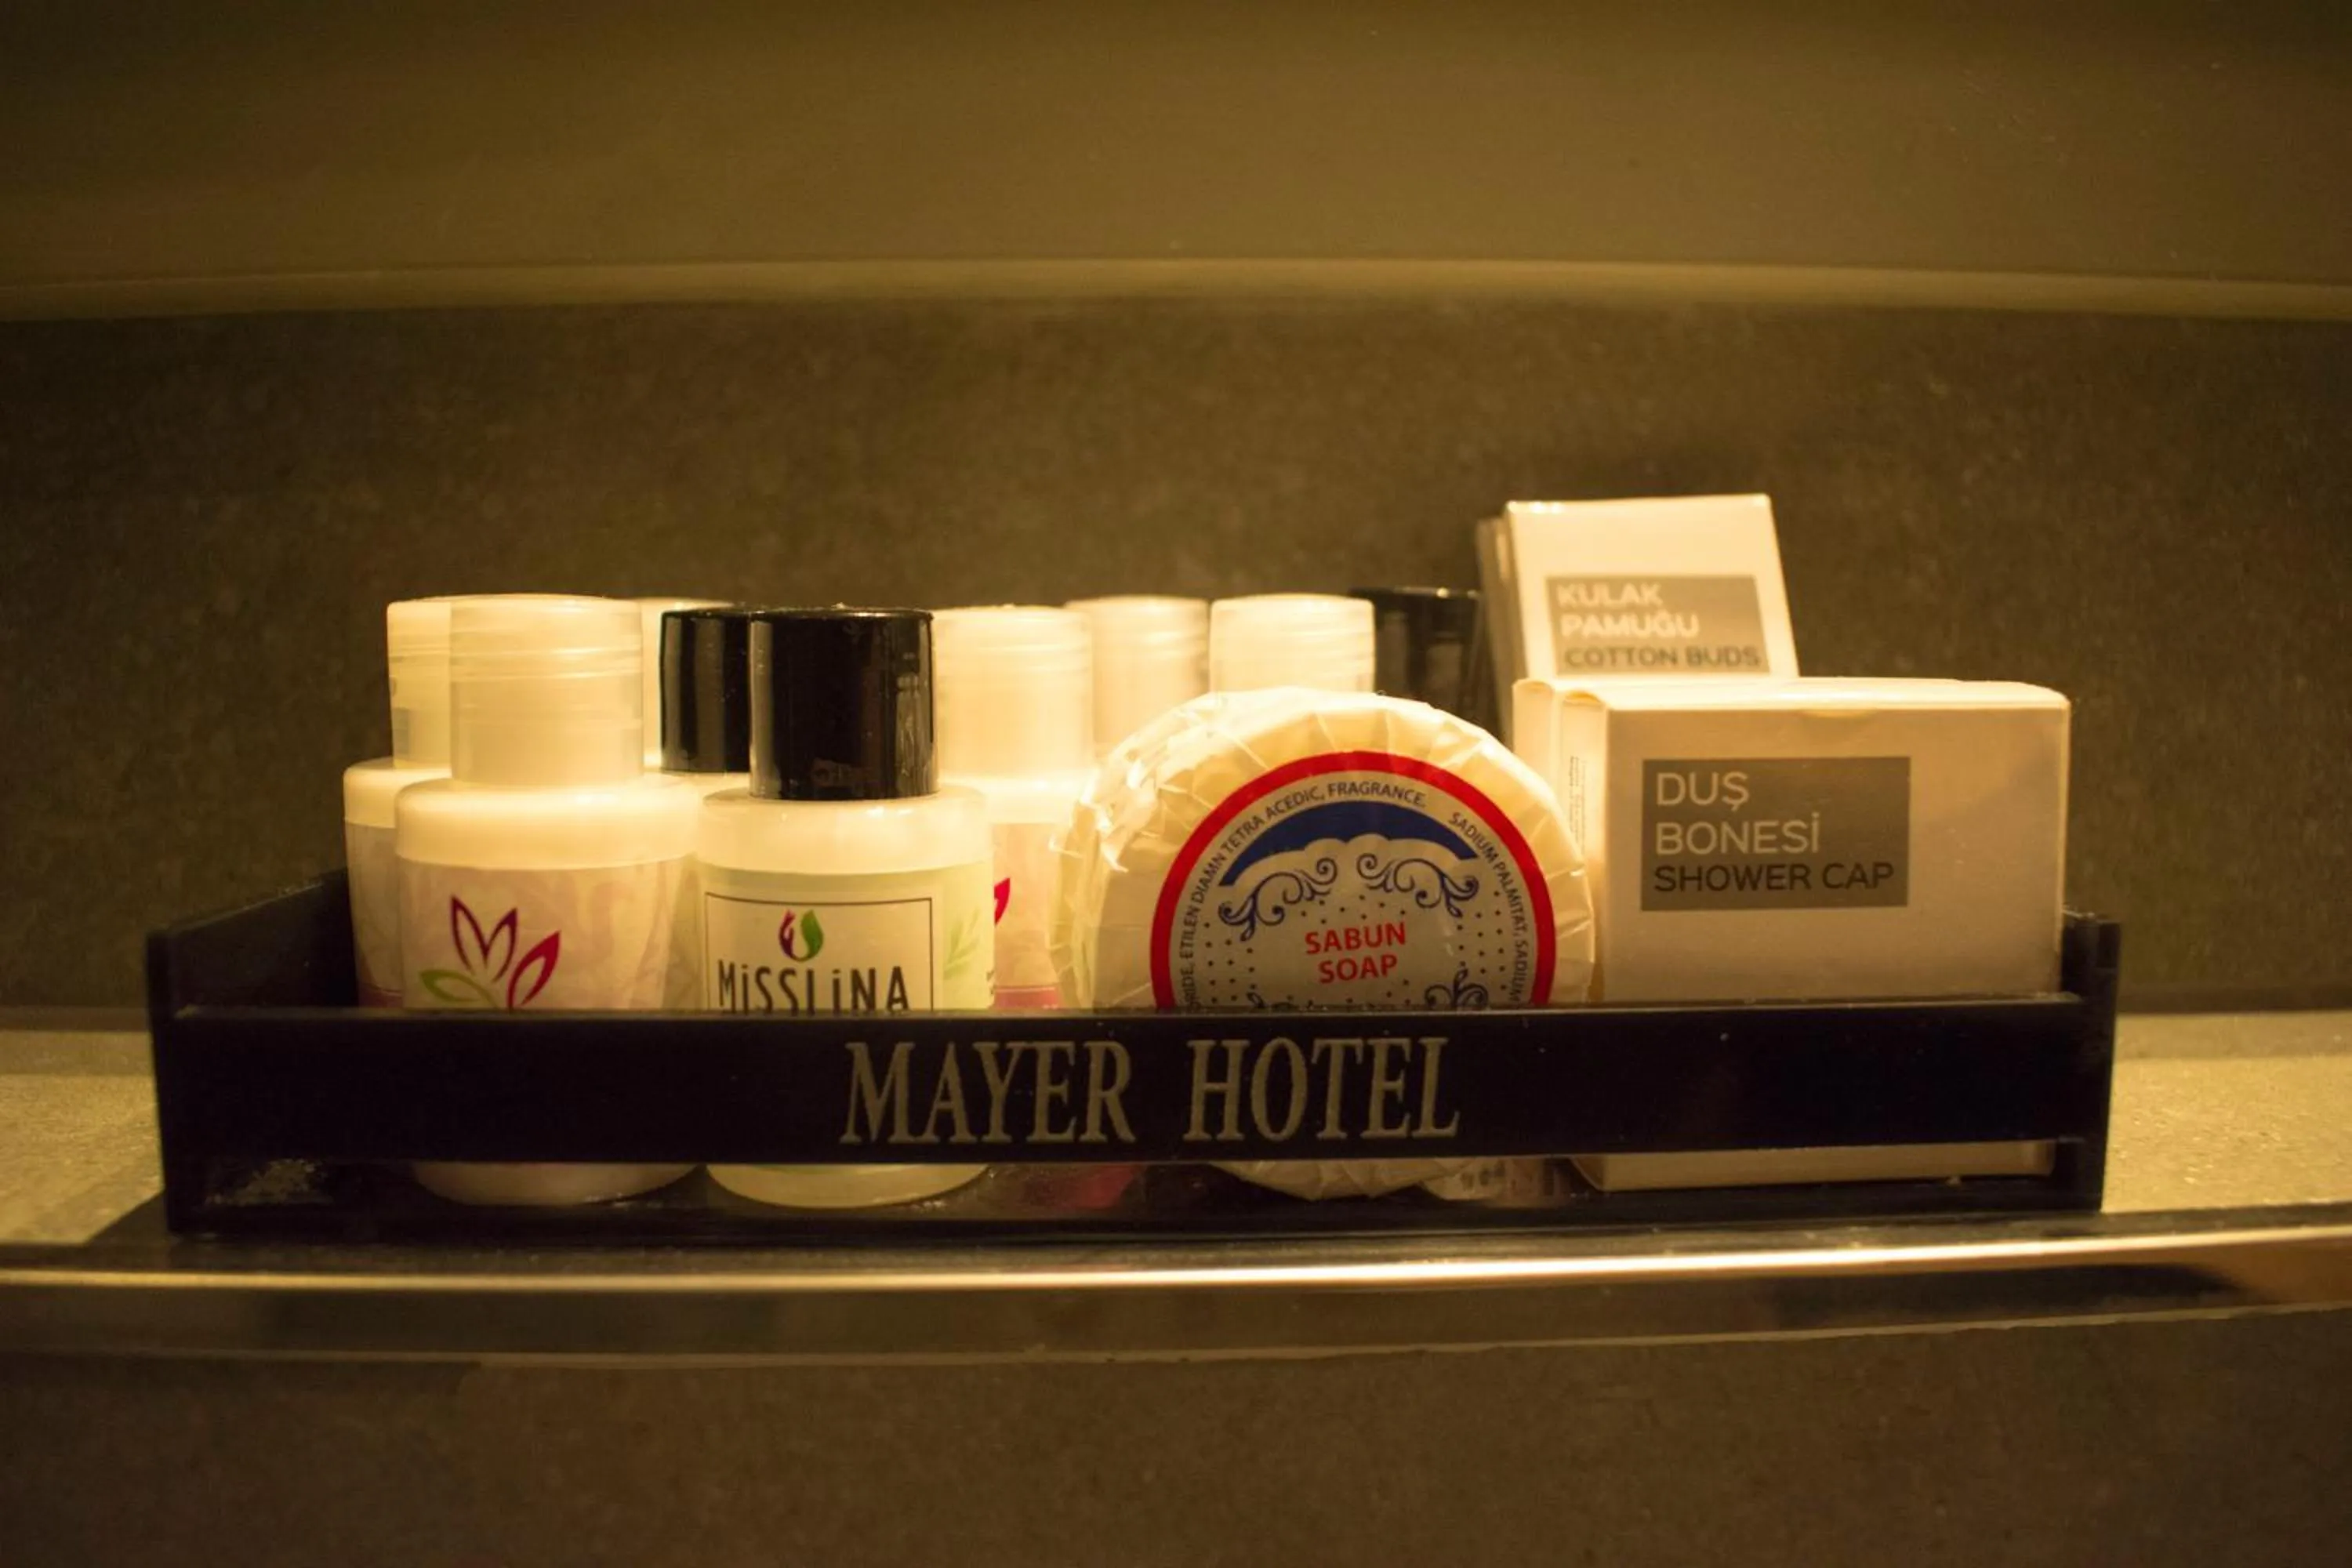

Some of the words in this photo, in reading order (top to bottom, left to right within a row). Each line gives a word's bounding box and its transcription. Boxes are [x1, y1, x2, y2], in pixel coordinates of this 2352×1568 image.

[1556, 583, 1663, 608] KULAK
[1560, 608, 1700, 638] PAMUĞU
[1564, 646, 1678, 667] COTTON
[1686, 645, 1761, 667] BUDS
[1656, 771, 1750, 811] DUŞ
[1448, 811, 1499, 864] SADIUM
[1655, 811, 1820, 855] BONESİ
[1179, 906, 1201, 959] ETILEN
[1191, 851, 1226, 904] DIAMN
[1220, 815, 1265, 854] TETRA
[1265, 786, 1325, 820] ACEDIC,
[1654, 862, 1812, 892] SHOWER
[1822, 862, 1894, 890] CAP
[1305, 921, 1406, 955] SABUN
[1319, 953, 1398, 984] SOAP
[839, 1040, 1137, 1143] MAYER
[1182, 1036, 1460, 1142] HOTEL
